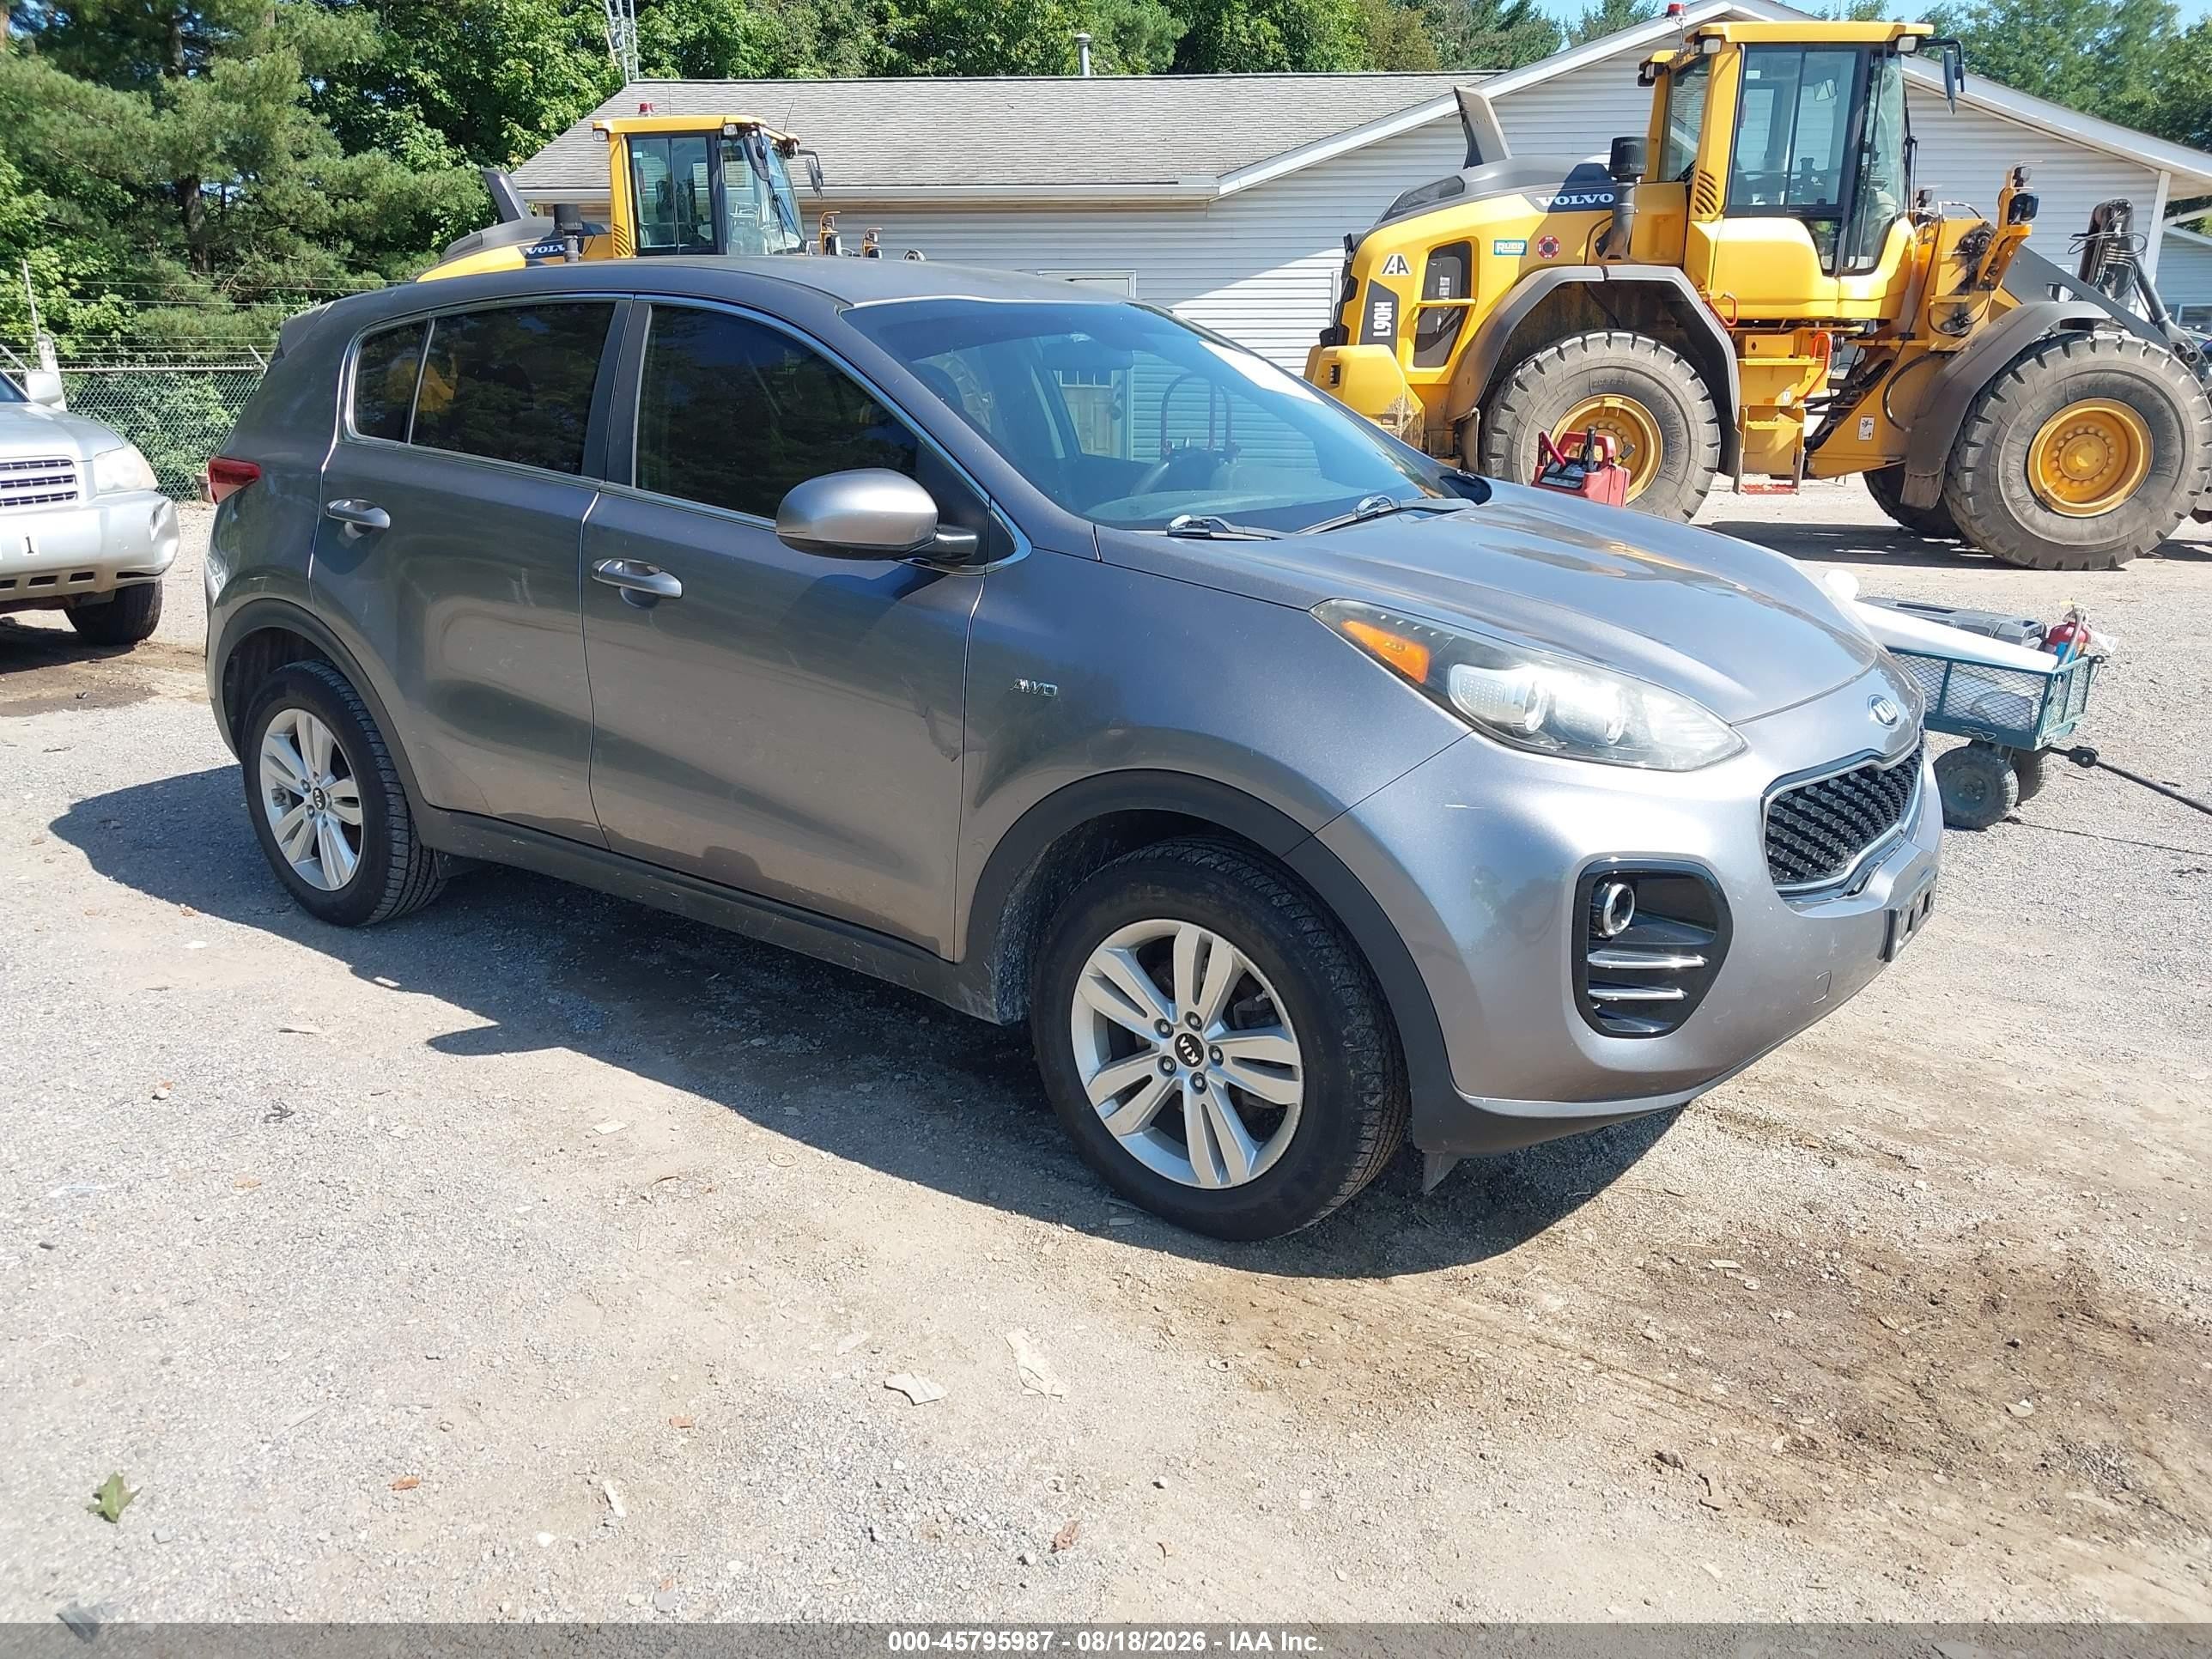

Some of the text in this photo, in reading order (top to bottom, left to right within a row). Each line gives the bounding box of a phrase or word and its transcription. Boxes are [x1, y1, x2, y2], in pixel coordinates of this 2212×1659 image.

[1535, 193, 1614, 207] VOLVO
[525, 244, 565, 255] VOLV
[1373, 301, 1393, 337] L90H
[1010, 678, 1058, 697] AWD
[1179, 1036, 1200, 1064] KIA
